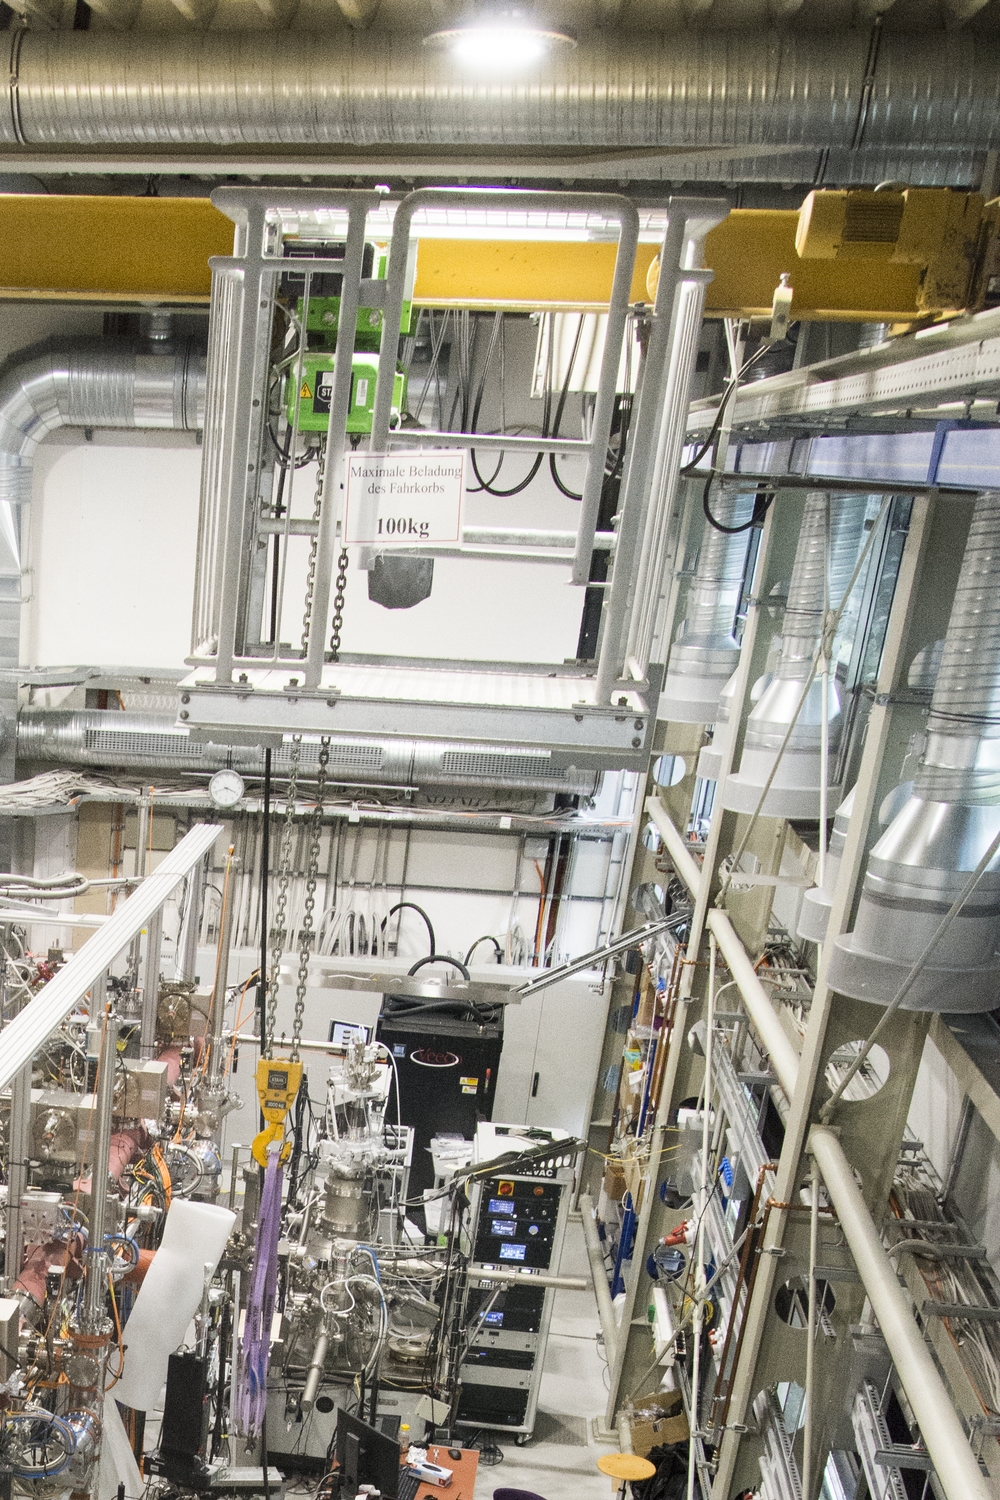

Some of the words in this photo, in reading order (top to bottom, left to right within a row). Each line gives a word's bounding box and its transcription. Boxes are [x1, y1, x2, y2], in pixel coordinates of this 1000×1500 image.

[350, 465, 405, 478] Maximale
[409, 465, 462, 479] Beladung
[367, 483, 386, 494] des
[390, 482, 445, 494] Fahrkorbs
[377, 518, 430, 539] 100kg
